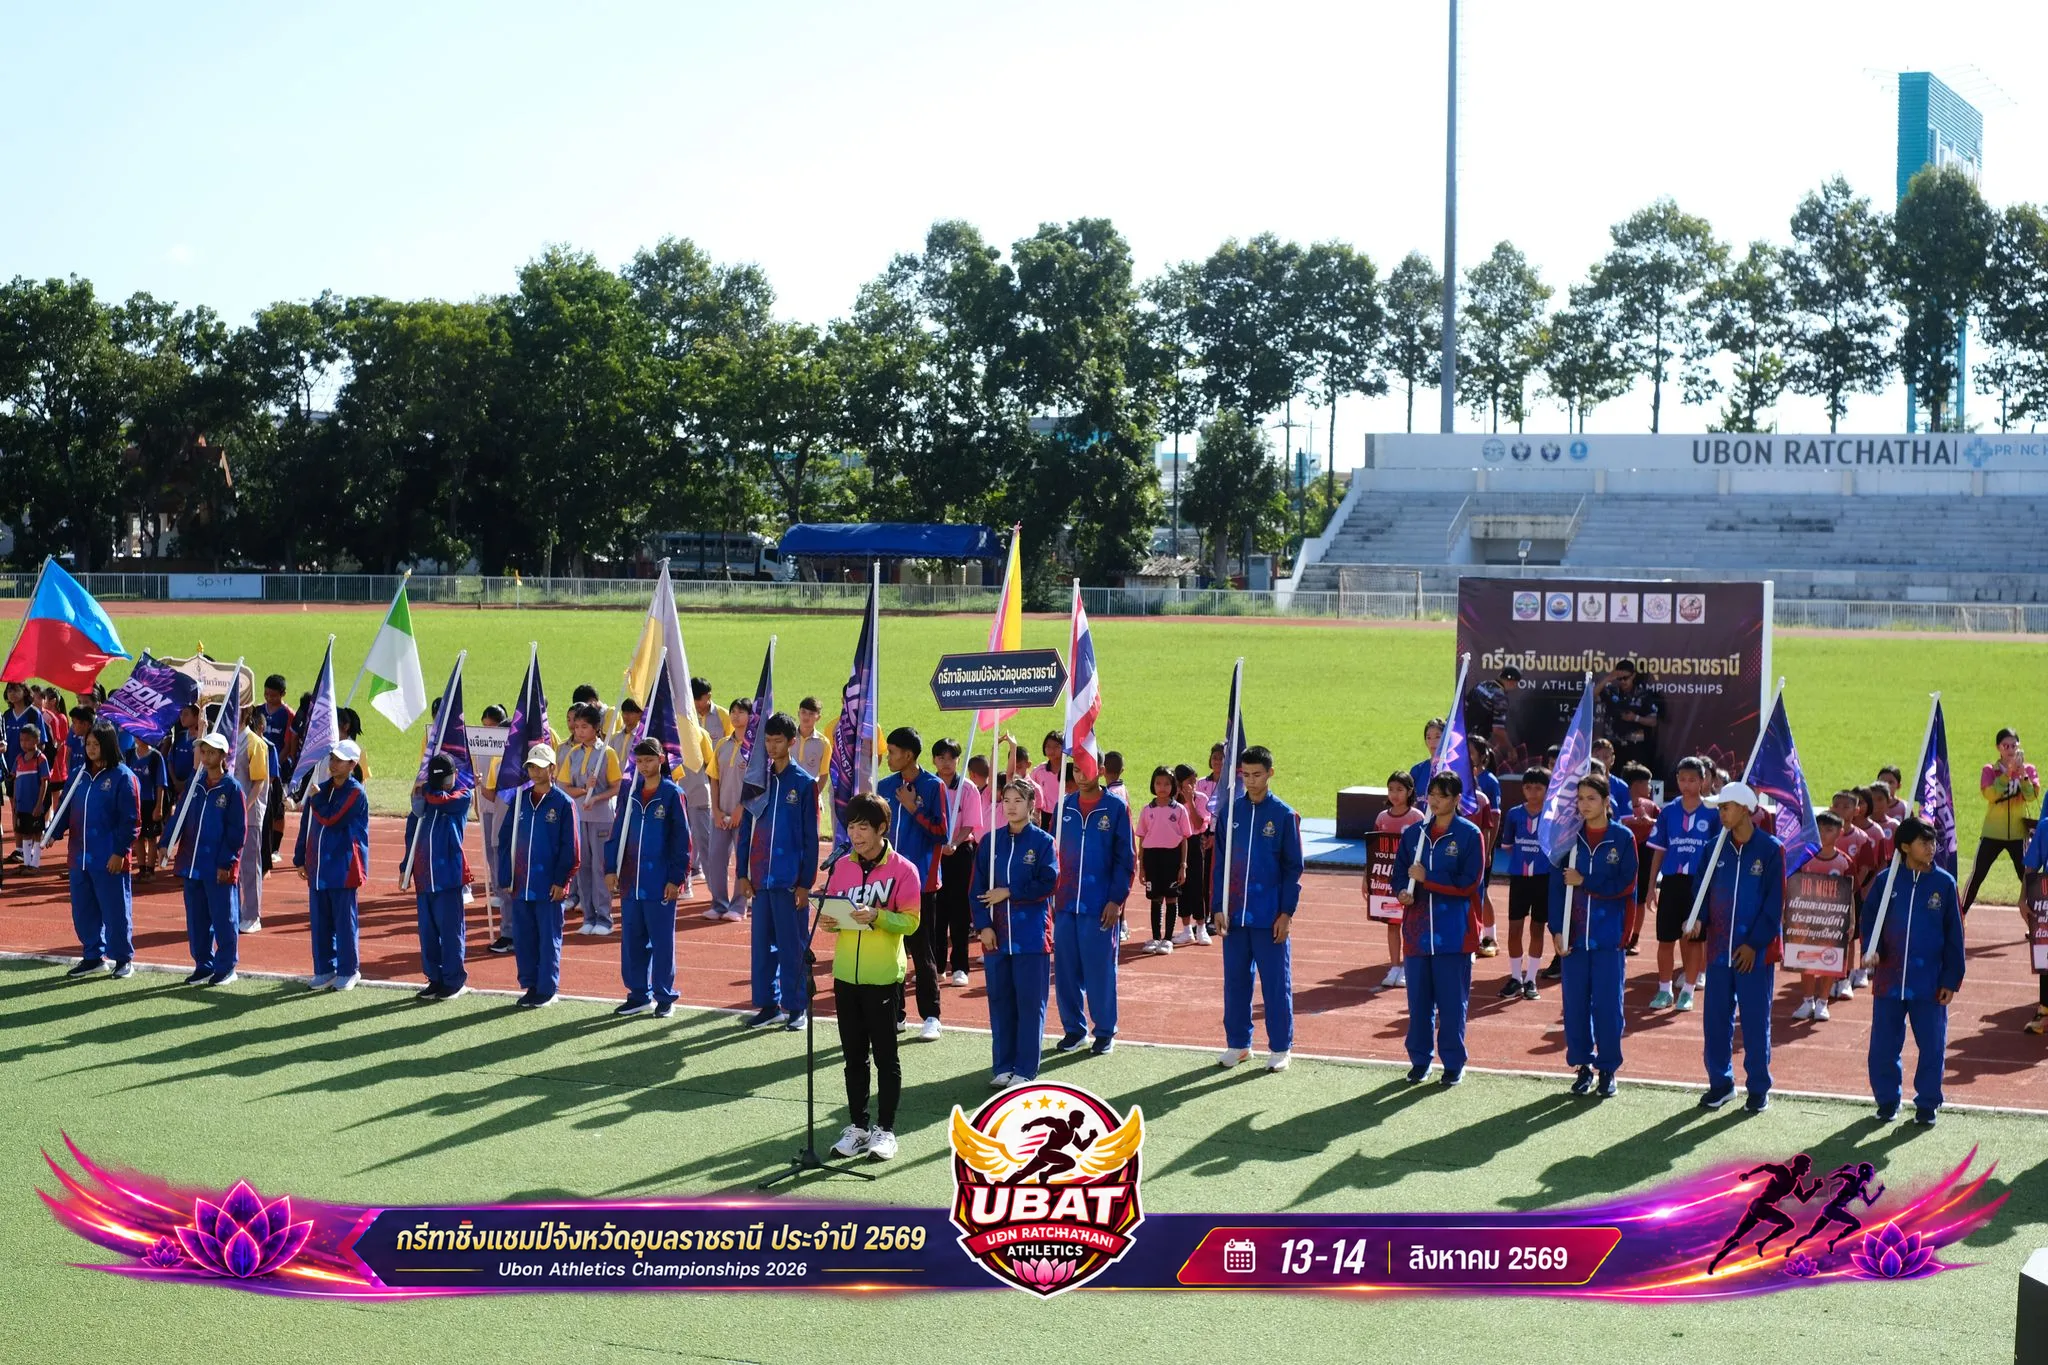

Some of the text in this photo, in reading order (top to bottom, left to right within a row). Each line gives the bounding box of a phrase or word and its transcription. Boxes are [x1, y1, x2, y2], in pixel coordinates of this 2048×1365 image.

[1692, 440, 1772, 465] UBON
[942, 685, 1053, 698] UBON ATHLETICS CHAMPIONSHIPS
